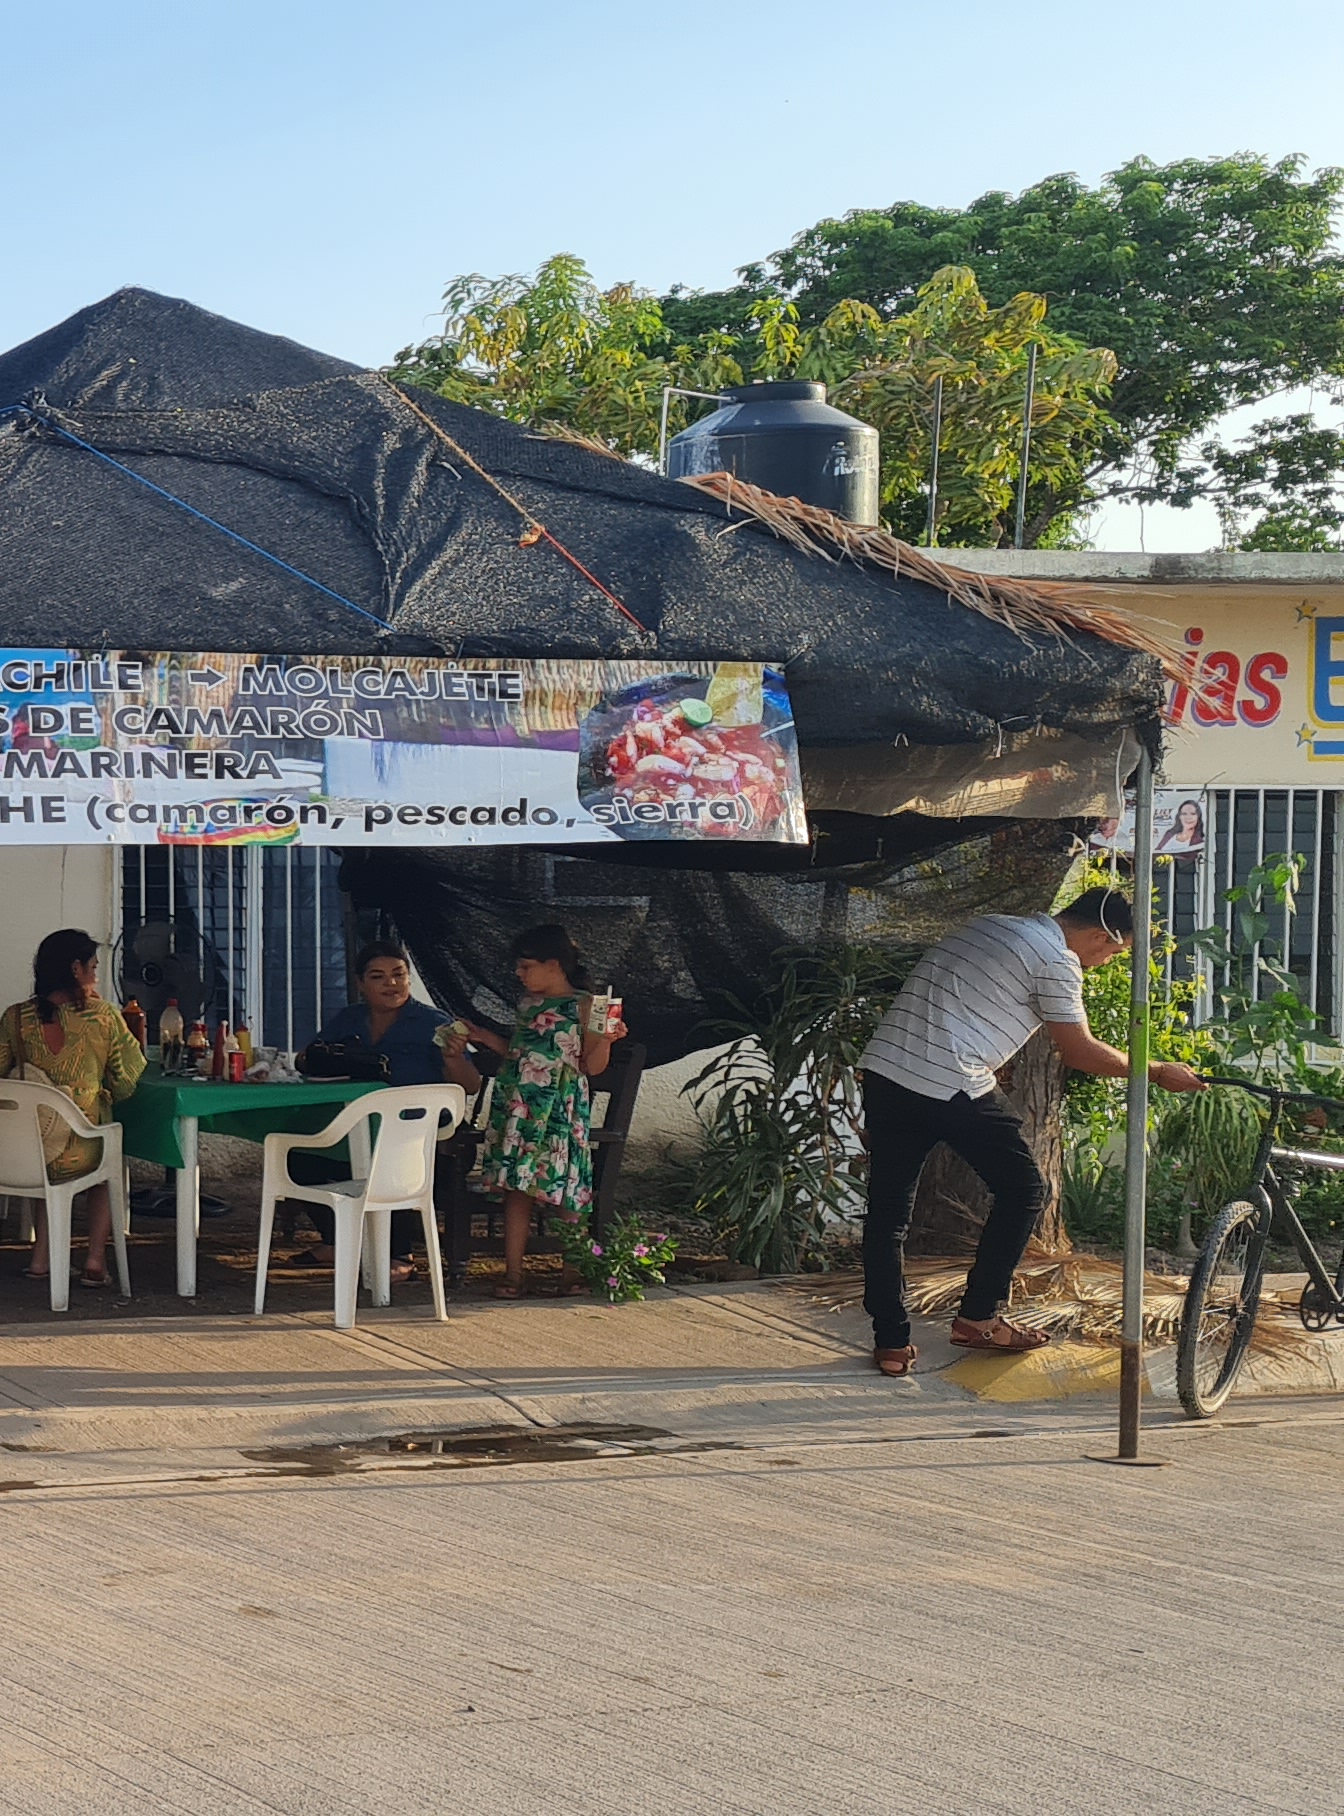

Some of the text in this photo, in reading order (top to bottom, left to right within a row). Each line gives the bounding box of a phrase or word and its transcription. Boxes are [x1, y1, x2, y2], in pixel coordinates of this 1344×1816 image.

[239, 664, 523, 702] MOLCAJETE
[1165, 627, 1289, 727] ias
[28, 704, 97, 737] DE
[113, 700, 384, 739] CAMARÓN
[3, 749, 284, 781] MARINERA
[86, 795, 345, 832] (camarón,
[365, 797, 578, 832] pescado,
[593, 792, 756, 830] sierra)
